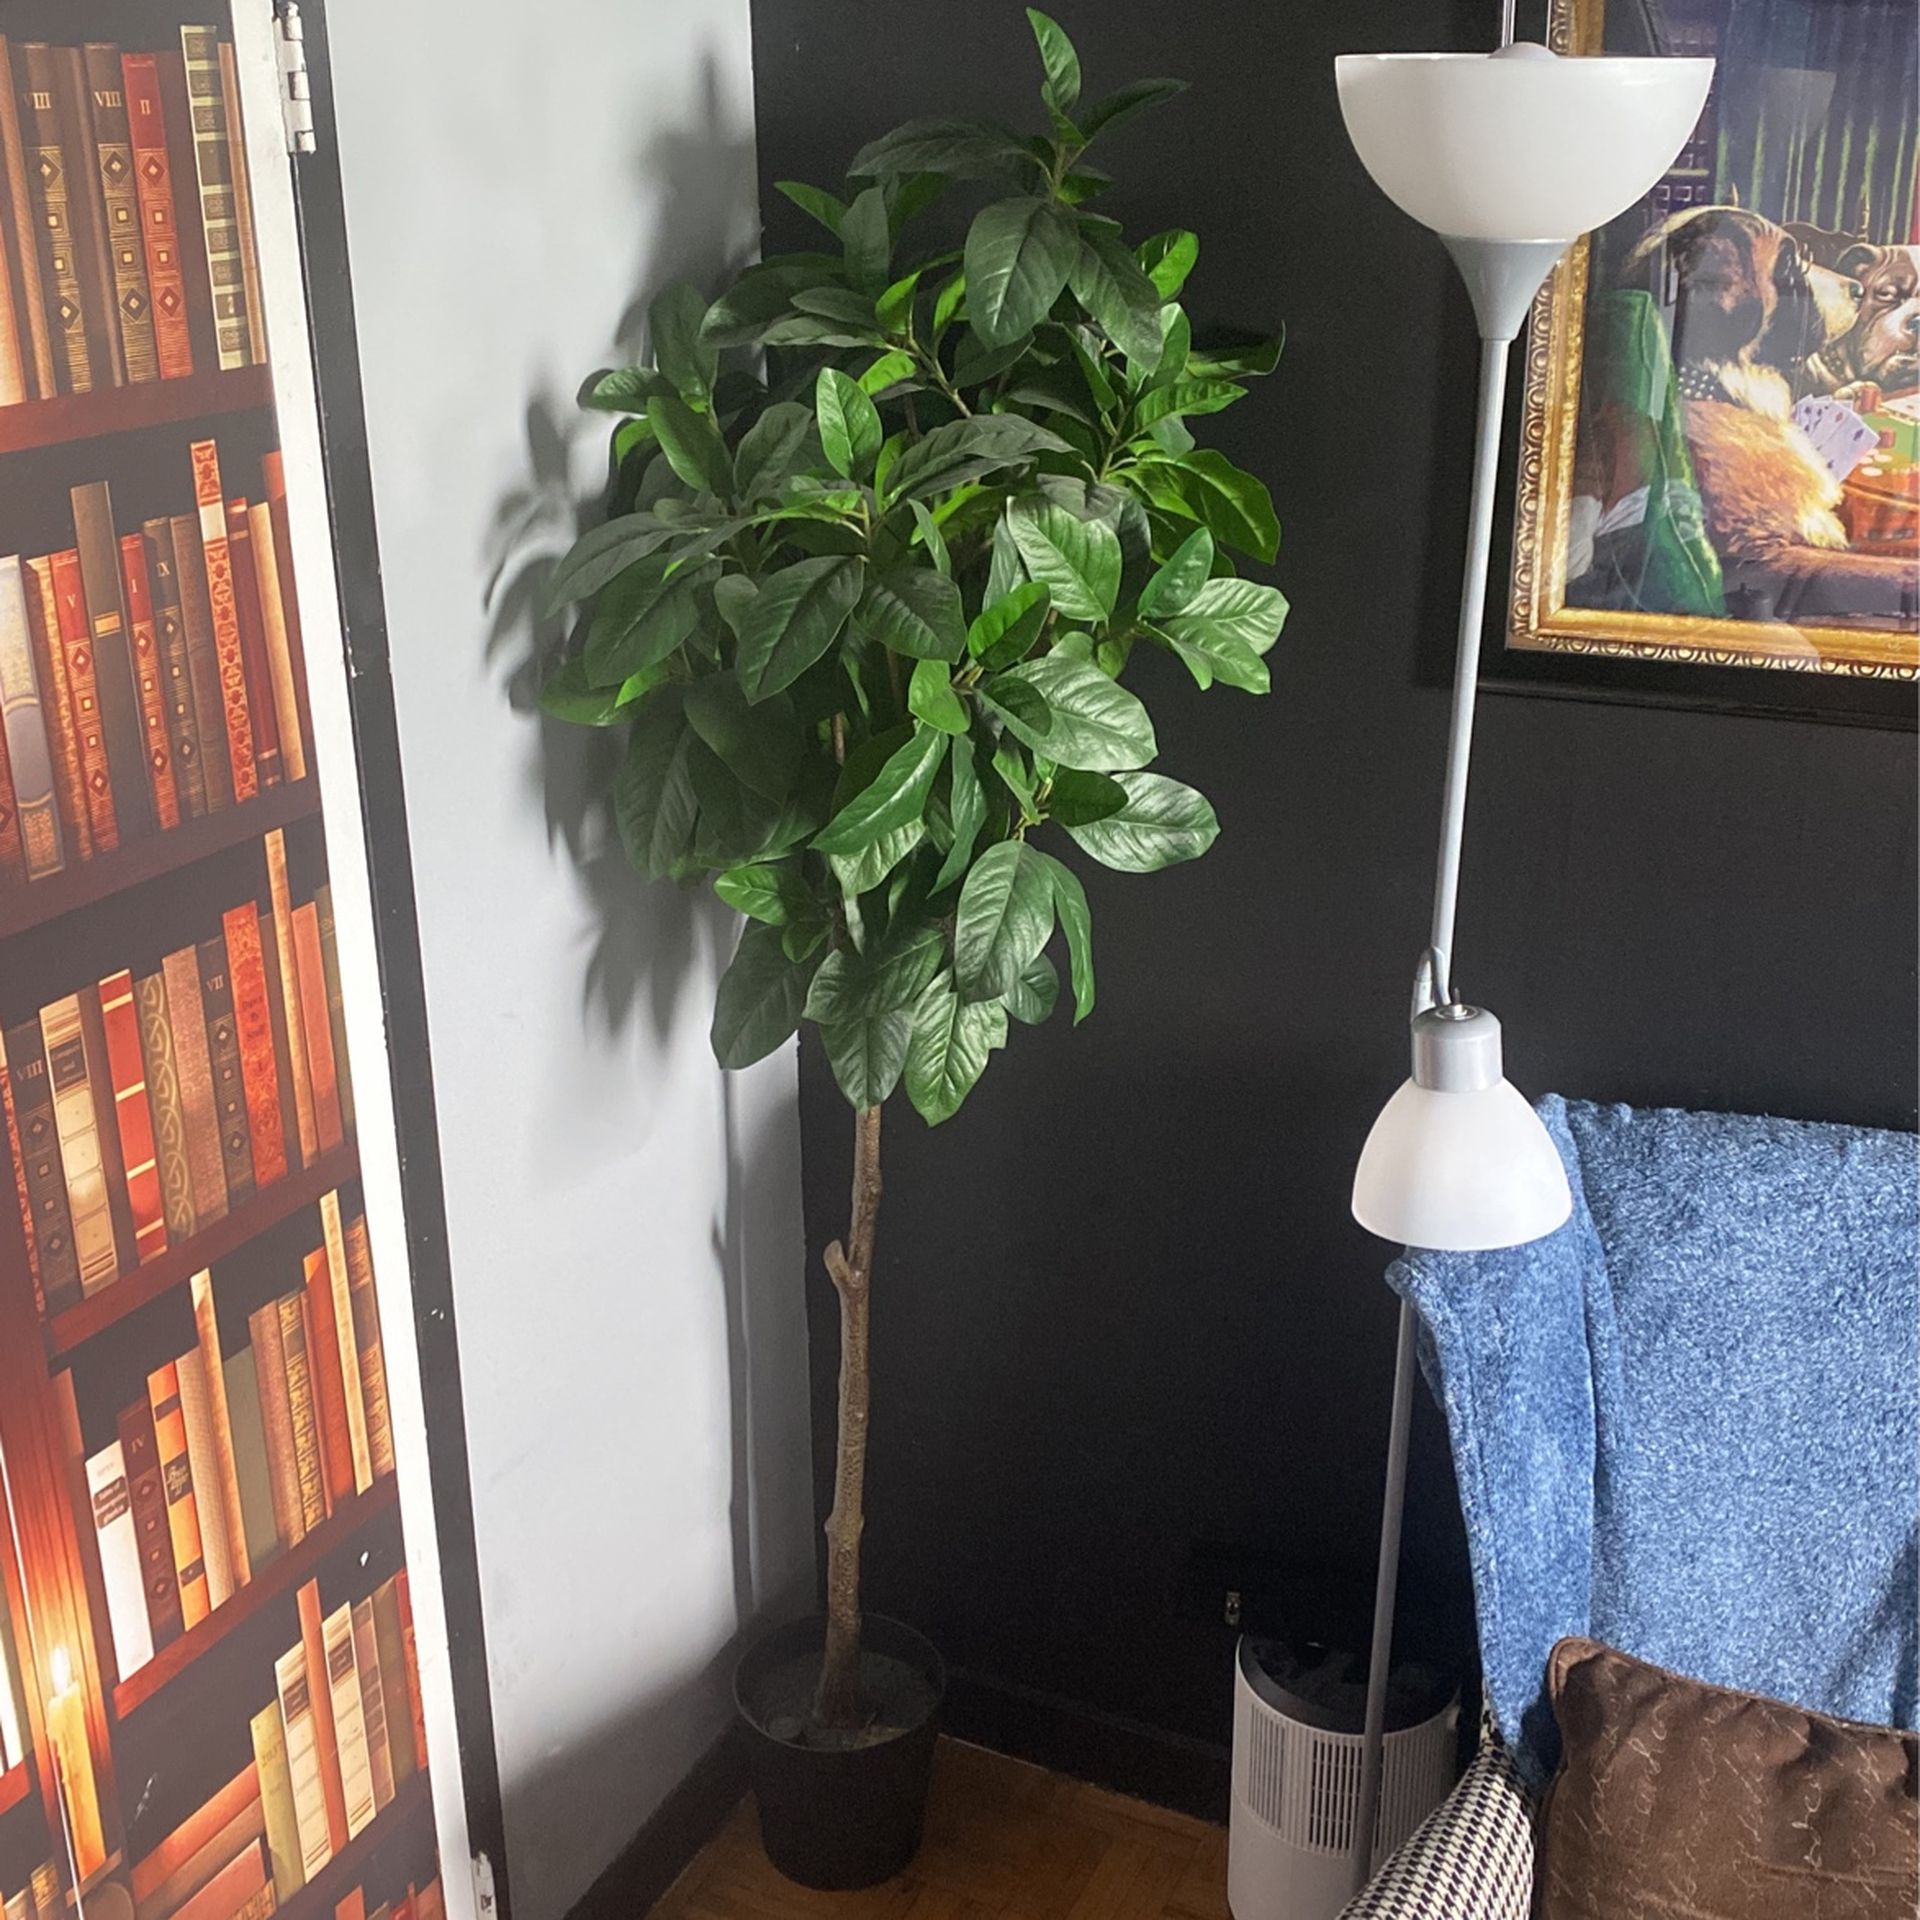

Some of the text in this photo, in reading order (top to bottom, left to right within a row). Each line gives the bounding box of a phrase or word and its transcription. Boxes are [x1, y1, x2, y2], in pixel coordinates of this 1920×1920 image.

[93, 90, 122, 108] VIII
[139, 99, 151, 115] II
[66, 593, 76, 609] V
[131, 1434, 146, 1454] IV
